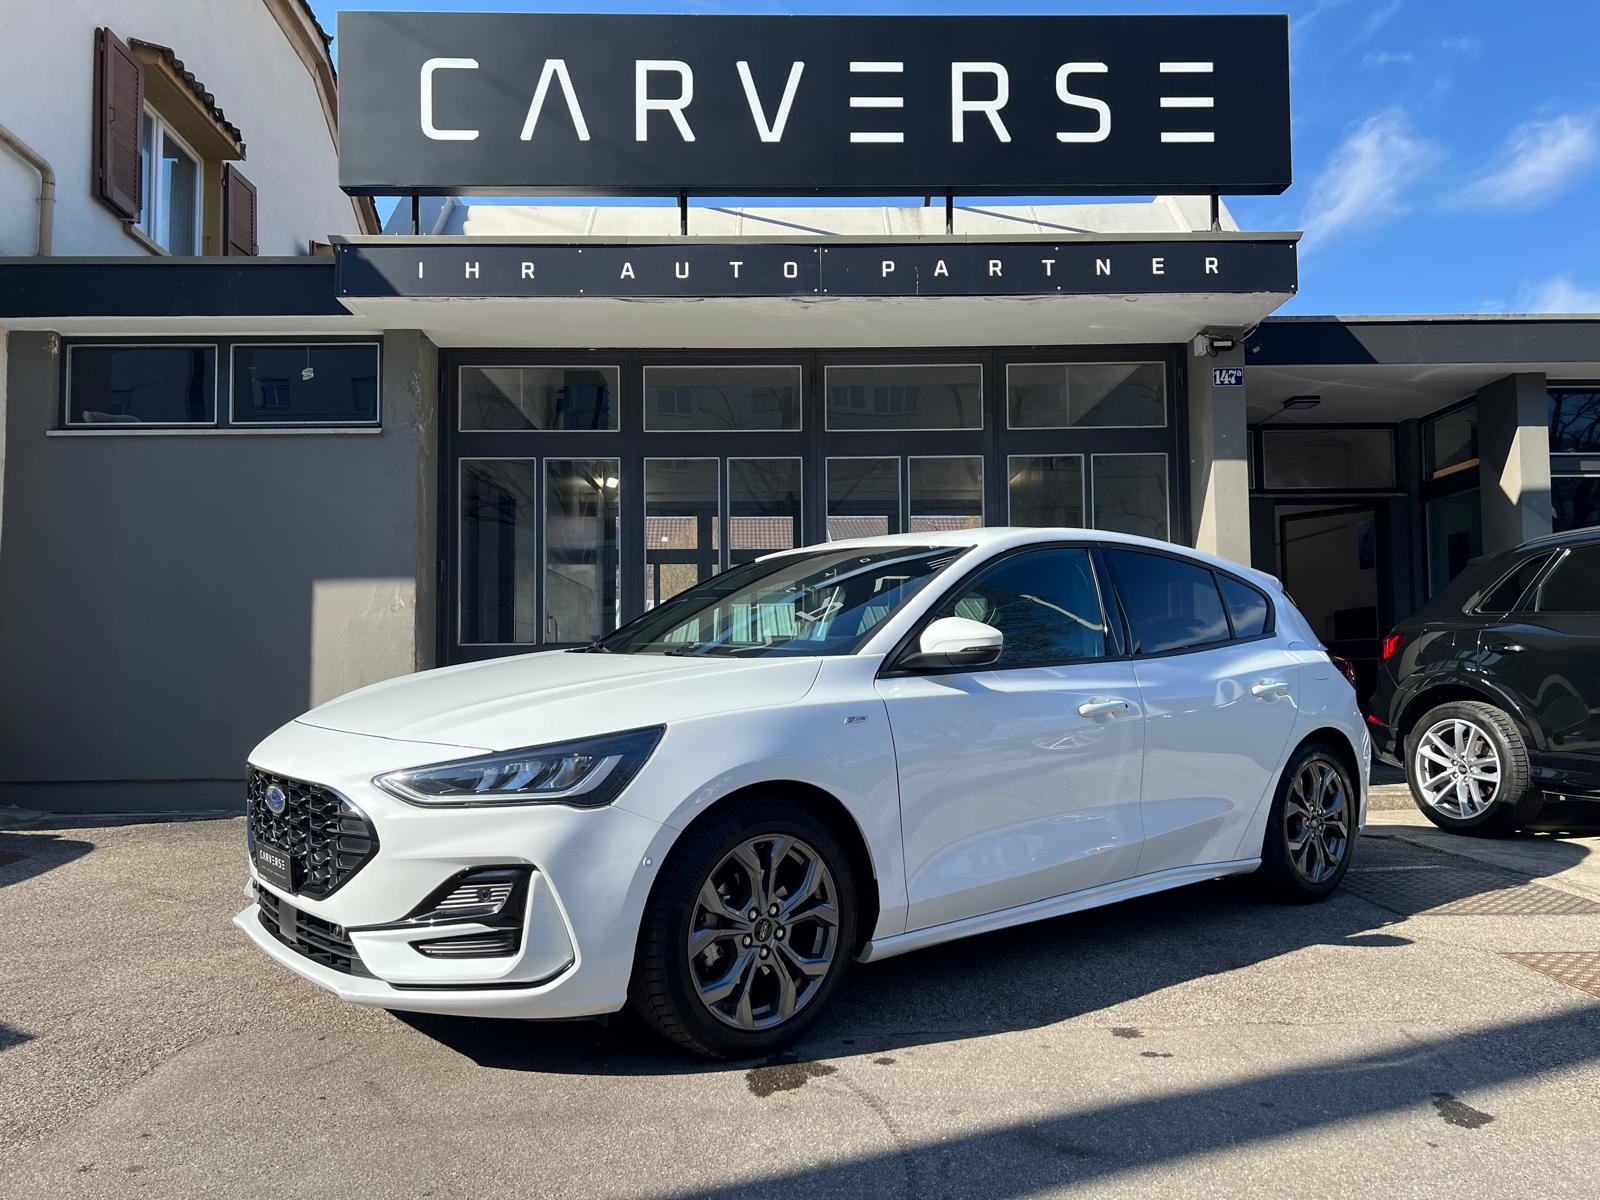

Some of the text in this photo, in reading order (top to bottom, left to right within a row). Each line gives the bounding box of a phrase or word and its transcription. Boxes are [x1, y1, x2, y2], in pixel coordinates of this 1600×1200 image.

[420, 58, 1215, 143] CARVERSE
[418, 256, 1221, 280] IHR AUTO PARTNER
